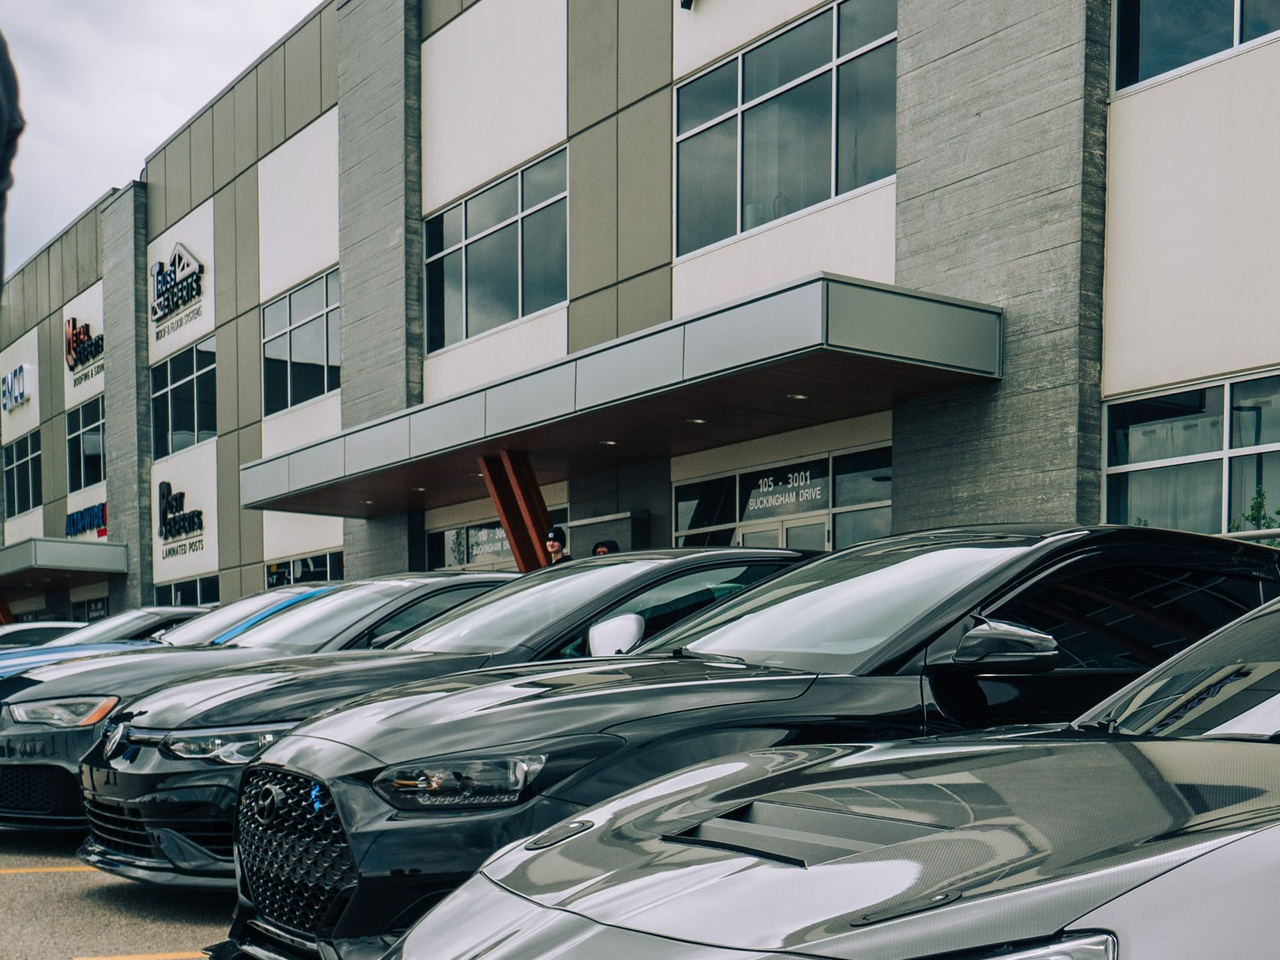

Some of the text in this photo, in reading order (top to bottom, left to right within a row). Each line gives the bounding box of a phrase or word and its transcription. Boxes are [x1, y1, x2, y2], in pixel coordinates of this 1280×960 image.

[759, 477, 774, 492] 105
[787, 471, 811, 488] 3001
[749, 487, 821, 510] BUCKINGHAM DRIVE
[188, 540, 204, 553] POSTS
